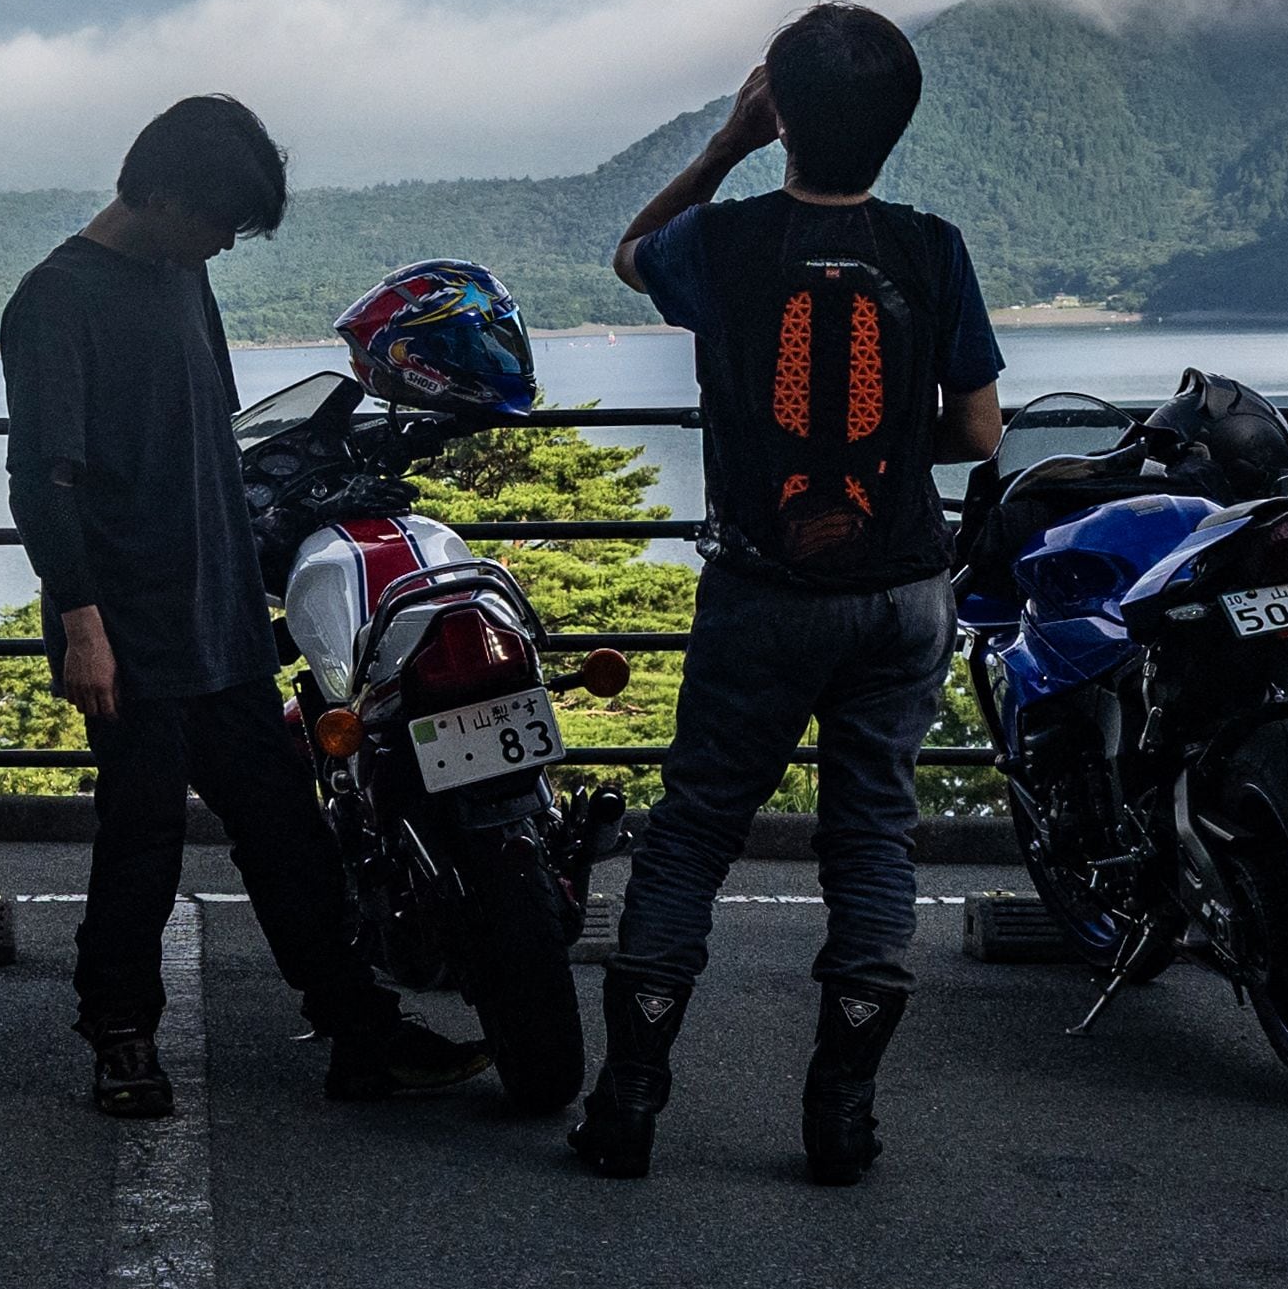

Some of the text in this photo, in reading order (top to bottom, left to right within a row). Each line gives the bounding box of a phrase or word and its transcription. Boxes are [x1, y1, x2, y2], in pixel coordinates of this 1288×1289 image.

[407, 372, 438, 392] SHOEI
[473, 704, 510, 730] 山梨
[523, 698, 538, 716] す
[499, 720, 553, 763] 83
